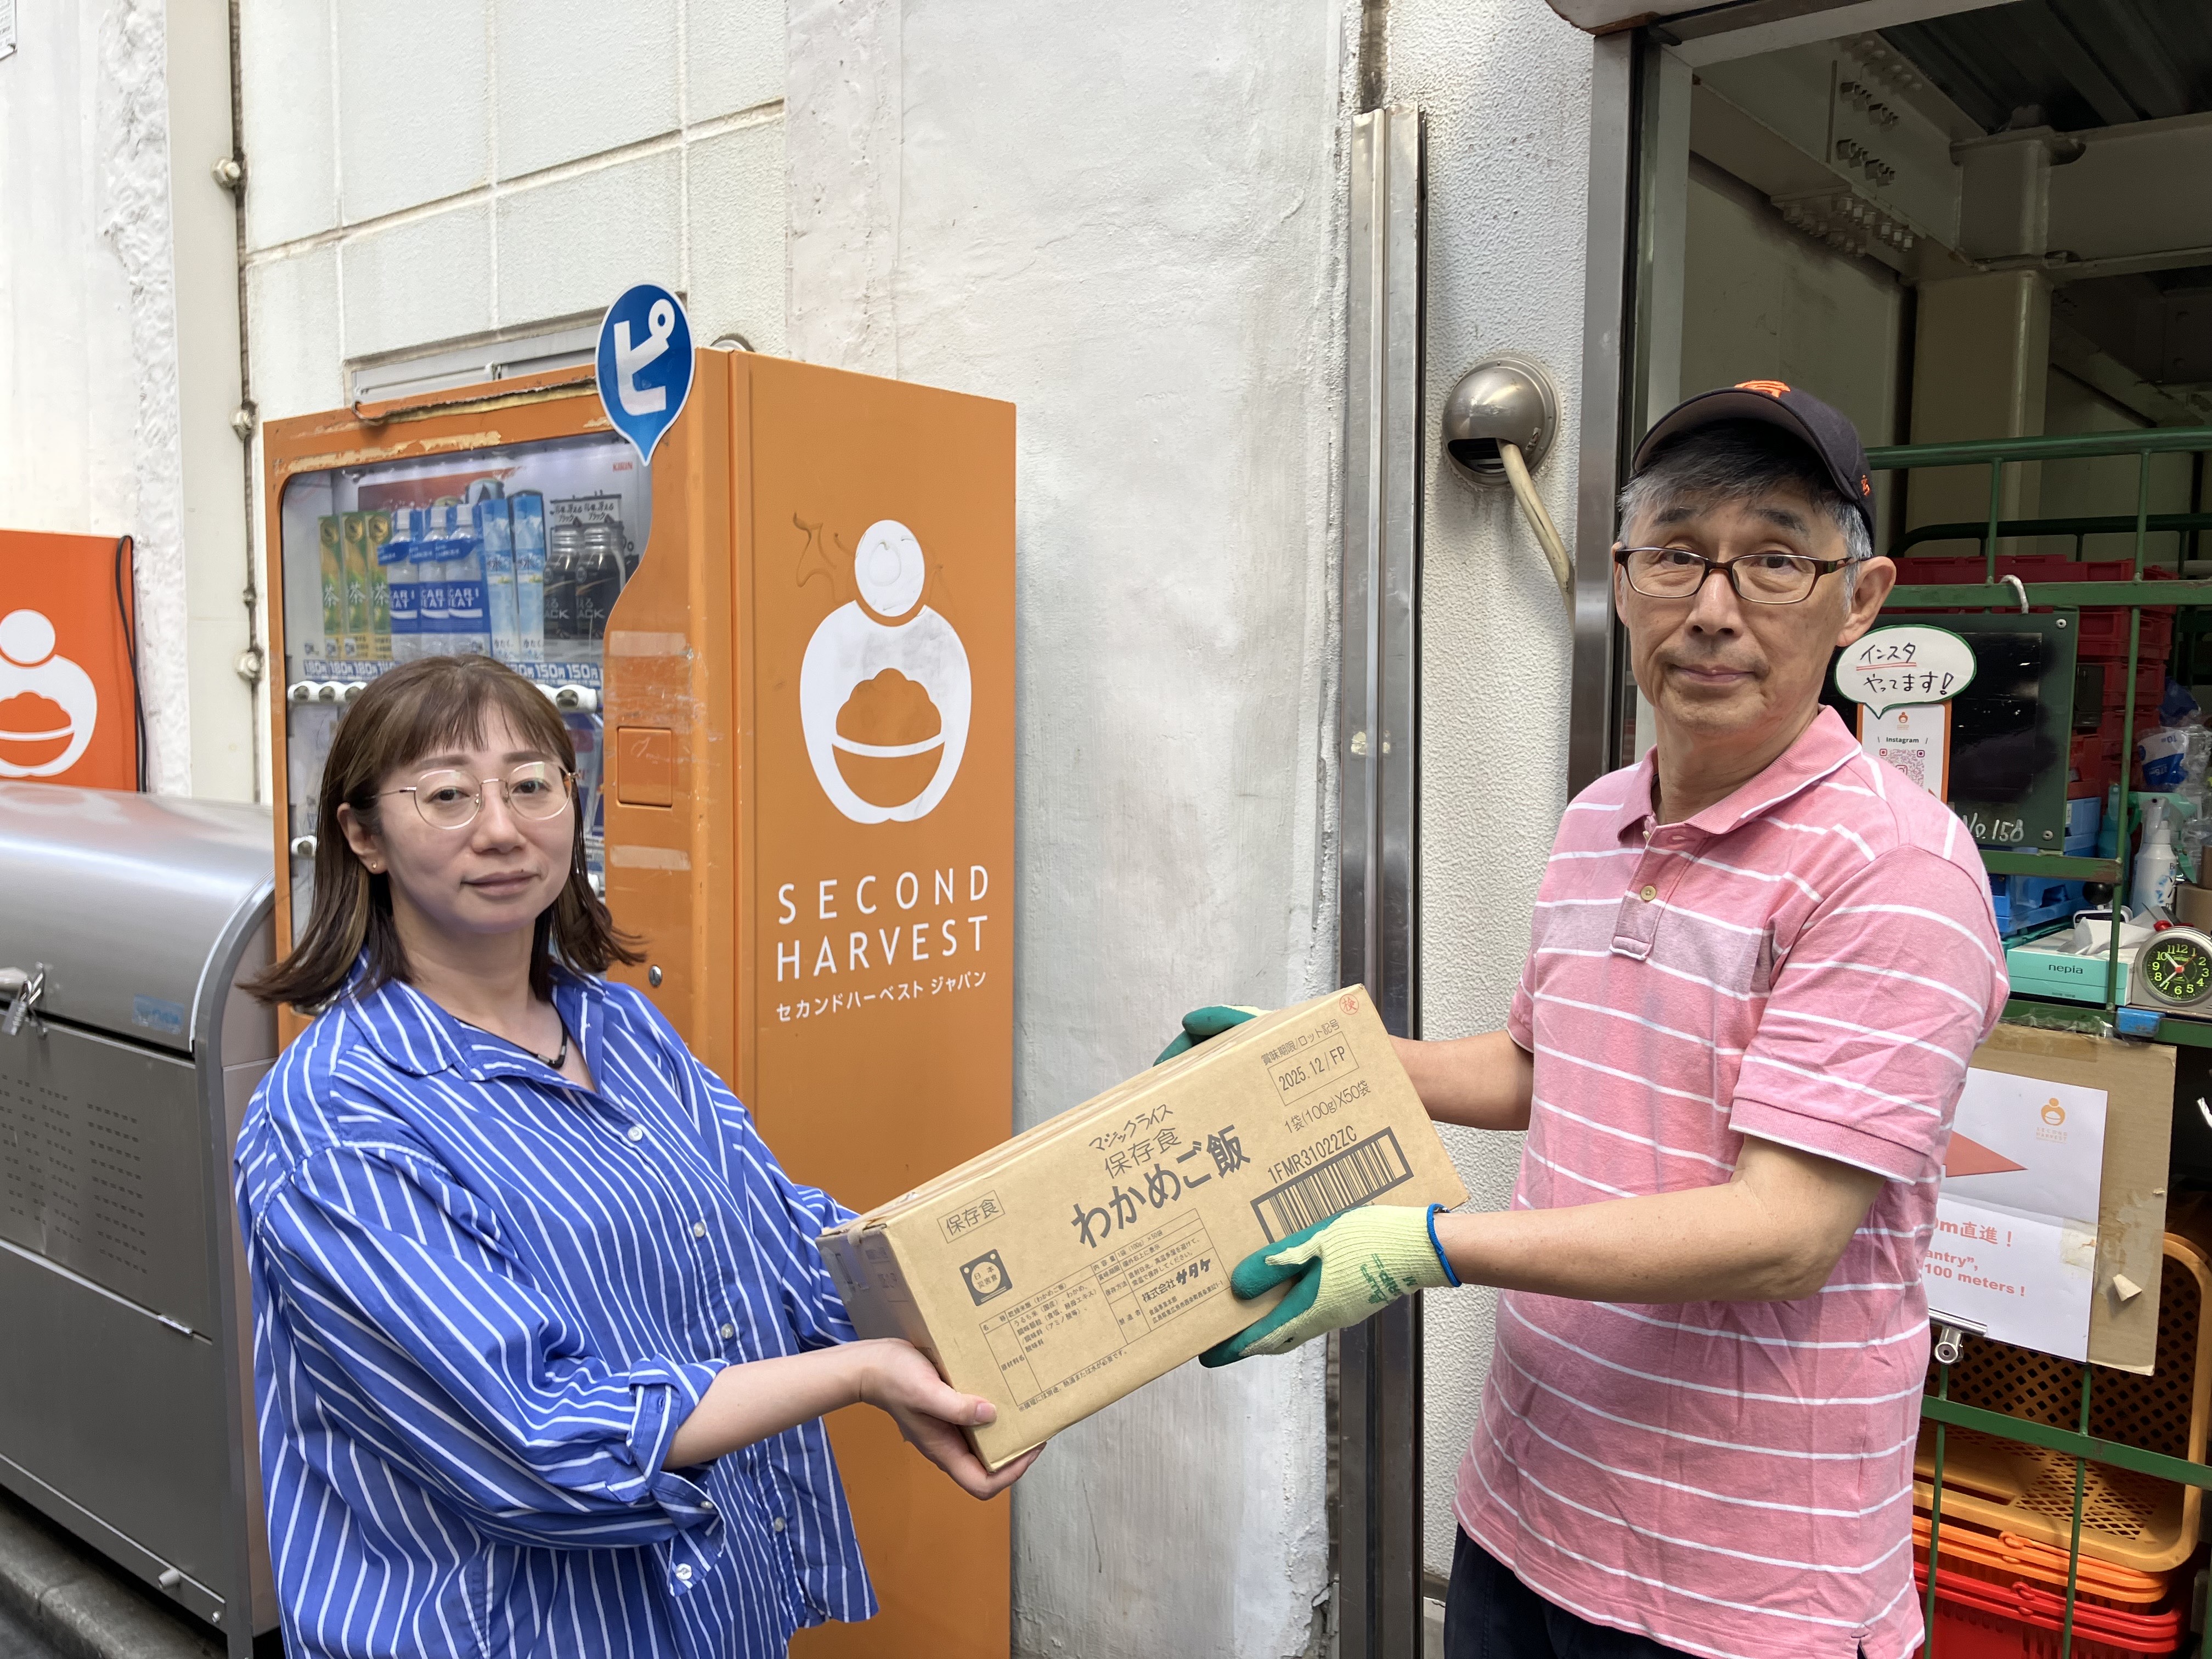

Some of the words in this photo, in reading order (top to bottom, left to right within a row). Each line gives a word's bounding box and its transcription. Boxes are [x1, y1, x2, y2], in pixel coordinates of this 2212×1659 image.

[614, 298, 675, 416] ピ
[1860, 642, 1916, 664] インスタ
[567, 663, 599, 679] 150円
[778, 865, 988, 924] SECOND
[777, 915, 988, 982] HARVEST
[2168, 945, 2175, 954] 11
[2176, 944, 2188, 953] 12
[2049, 964, 2083, 974] nepia
[2152, 962, 2160, 970] 9
[2199, 957, 2206, 966] 2
[2154, 972, 2162, 981] 8
[2197, 978, 2204, 986] 4
[2202, 968, 2209, 977] 3
[776, 980, 923, 1022] セカンドハーベスト
[931, 971, 986, 995] ジャパン
[2175, 986, 2182, 995] 6
[2186, 984, 2193, 993] 5
[1089, 1104, 1173, 1150] マジックライス
[1105, 1127, 1182, 1178] 保存食
[1267, 1125, 1357, 1183] 1FMR31022ZC
[1071, 1124, 1251, 1248] わかめご飯
[946, 1198, 999, 1235] 保存食
[1925, 1263, 1953, 1278] 100
[1958, 1273, 2015, 1294] meters
